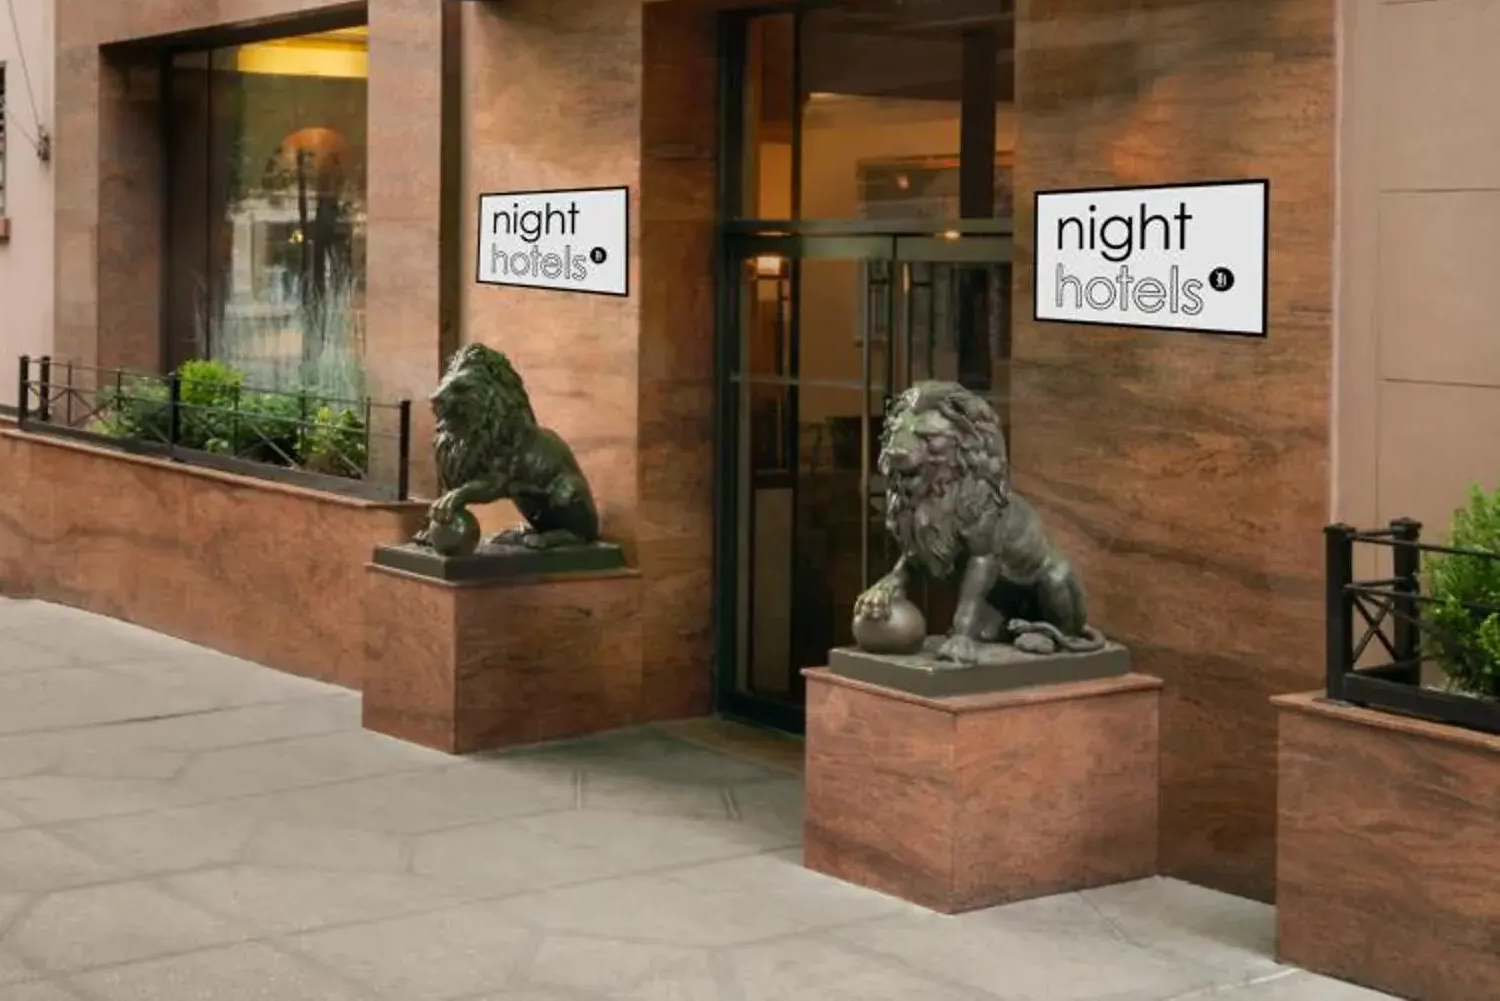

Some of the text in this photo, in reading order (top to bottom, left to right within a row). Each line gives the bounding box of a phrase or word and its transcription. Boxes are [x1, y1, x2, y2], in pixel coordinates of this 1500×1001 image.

[493, 201, 580, 243] night
[1057, 202, 1193, 262] night
[491, 242, 587, 281] hotels
[1055, 262, 1204, 316] hotels
